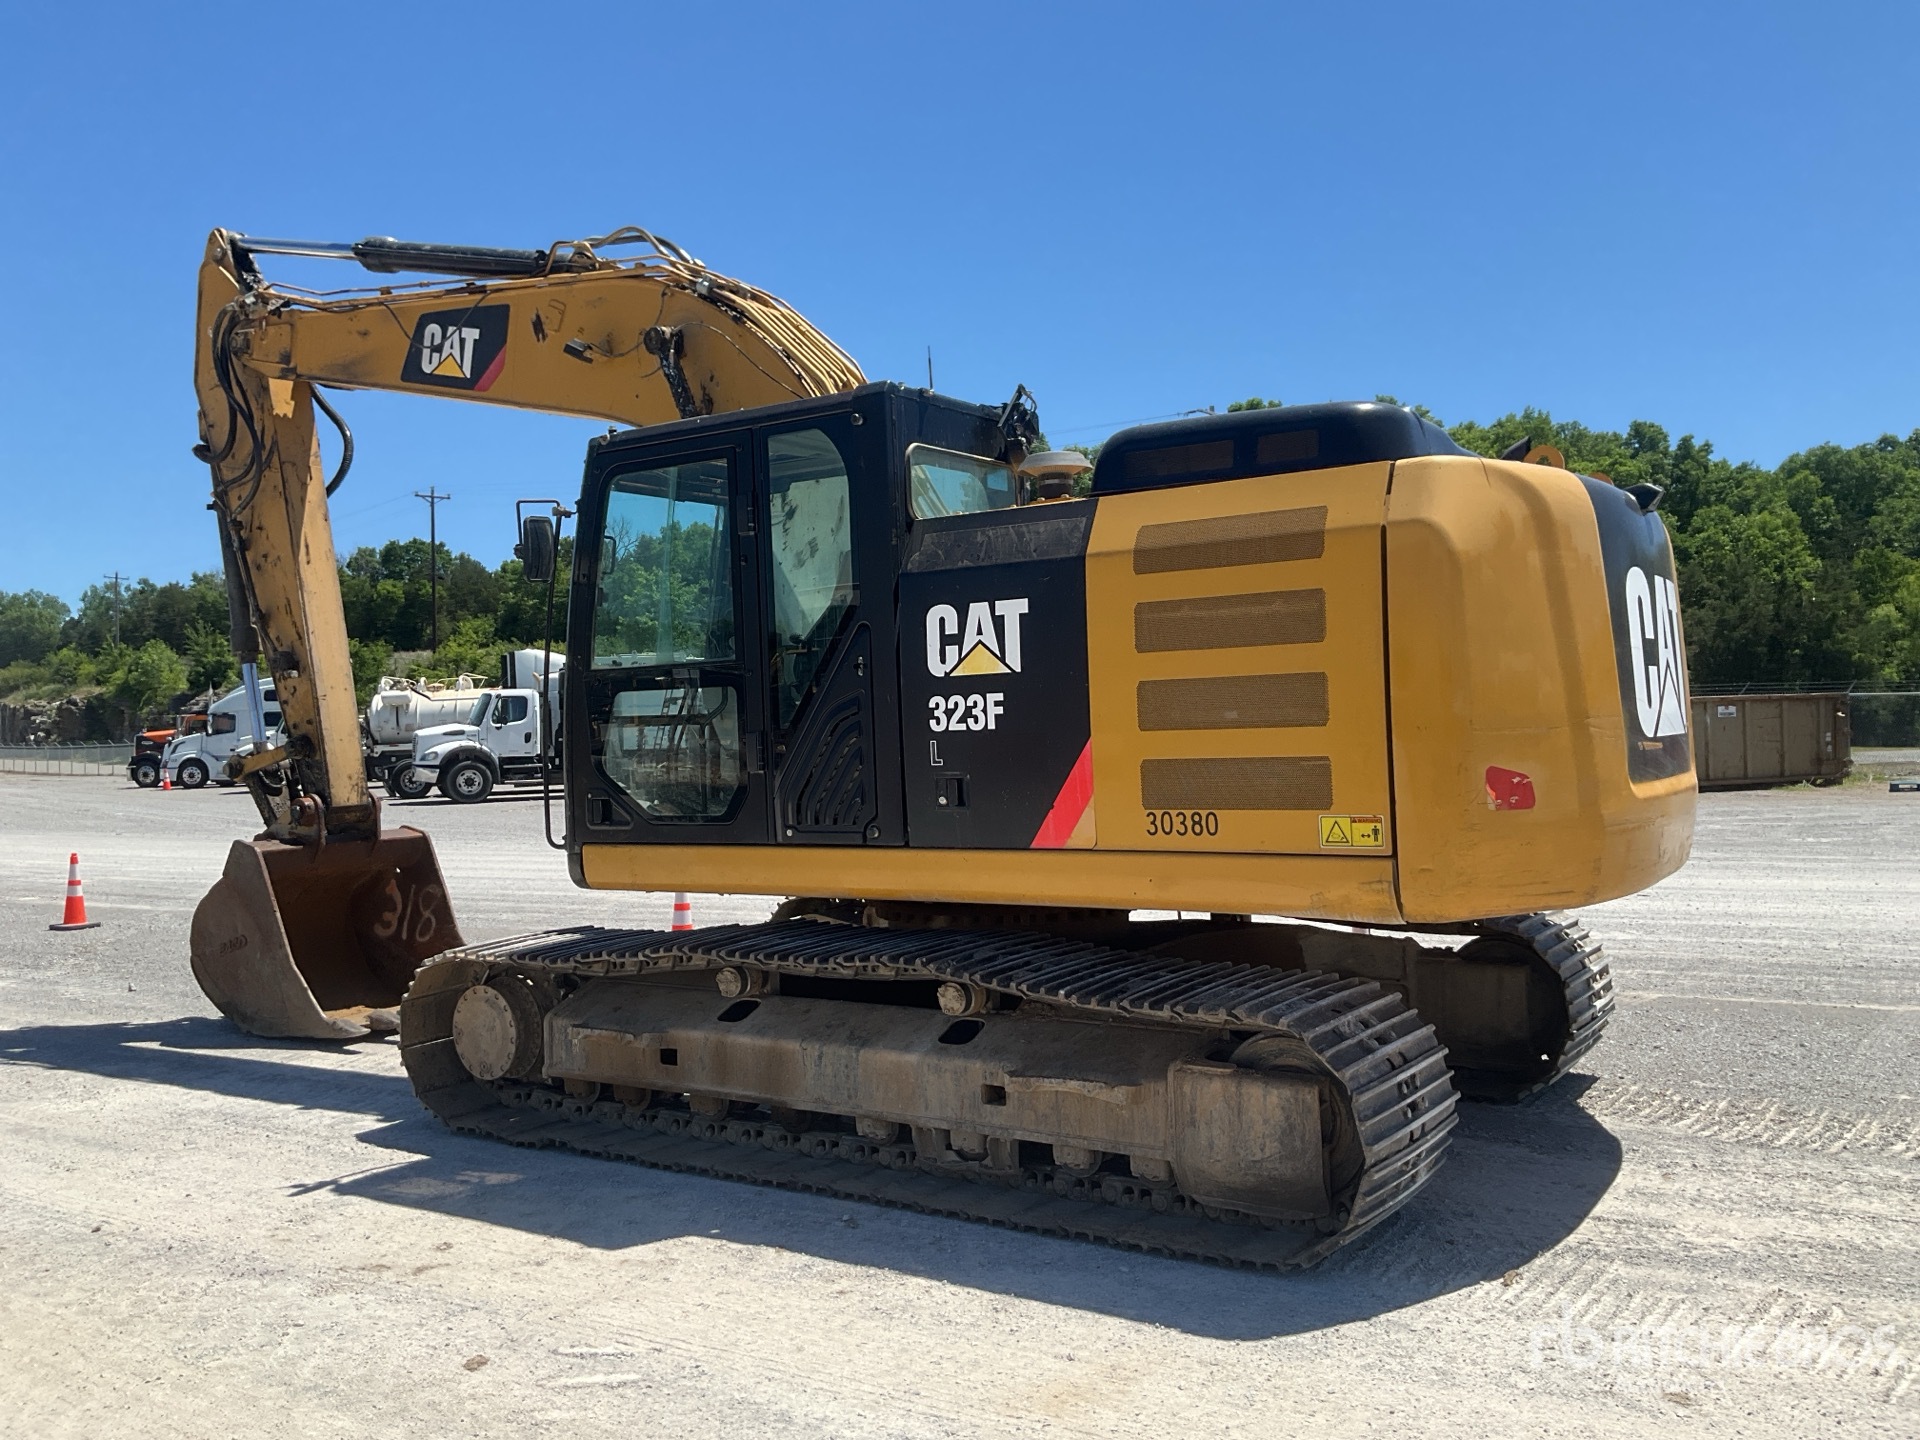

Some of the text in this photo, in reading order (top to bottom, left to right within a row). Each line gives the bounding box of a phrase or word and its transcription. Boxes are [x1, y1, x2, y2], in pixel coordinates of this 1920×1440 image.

[421, 323, 480, 379] CAT
[926, 598, 1029, 677] CAT
[1626, 566, 1687, 737] CAT
[928, 692, 1004, 732] 323F
[929, 740, 943, 766] L
[1145, 810, 1219, 837] 30380
